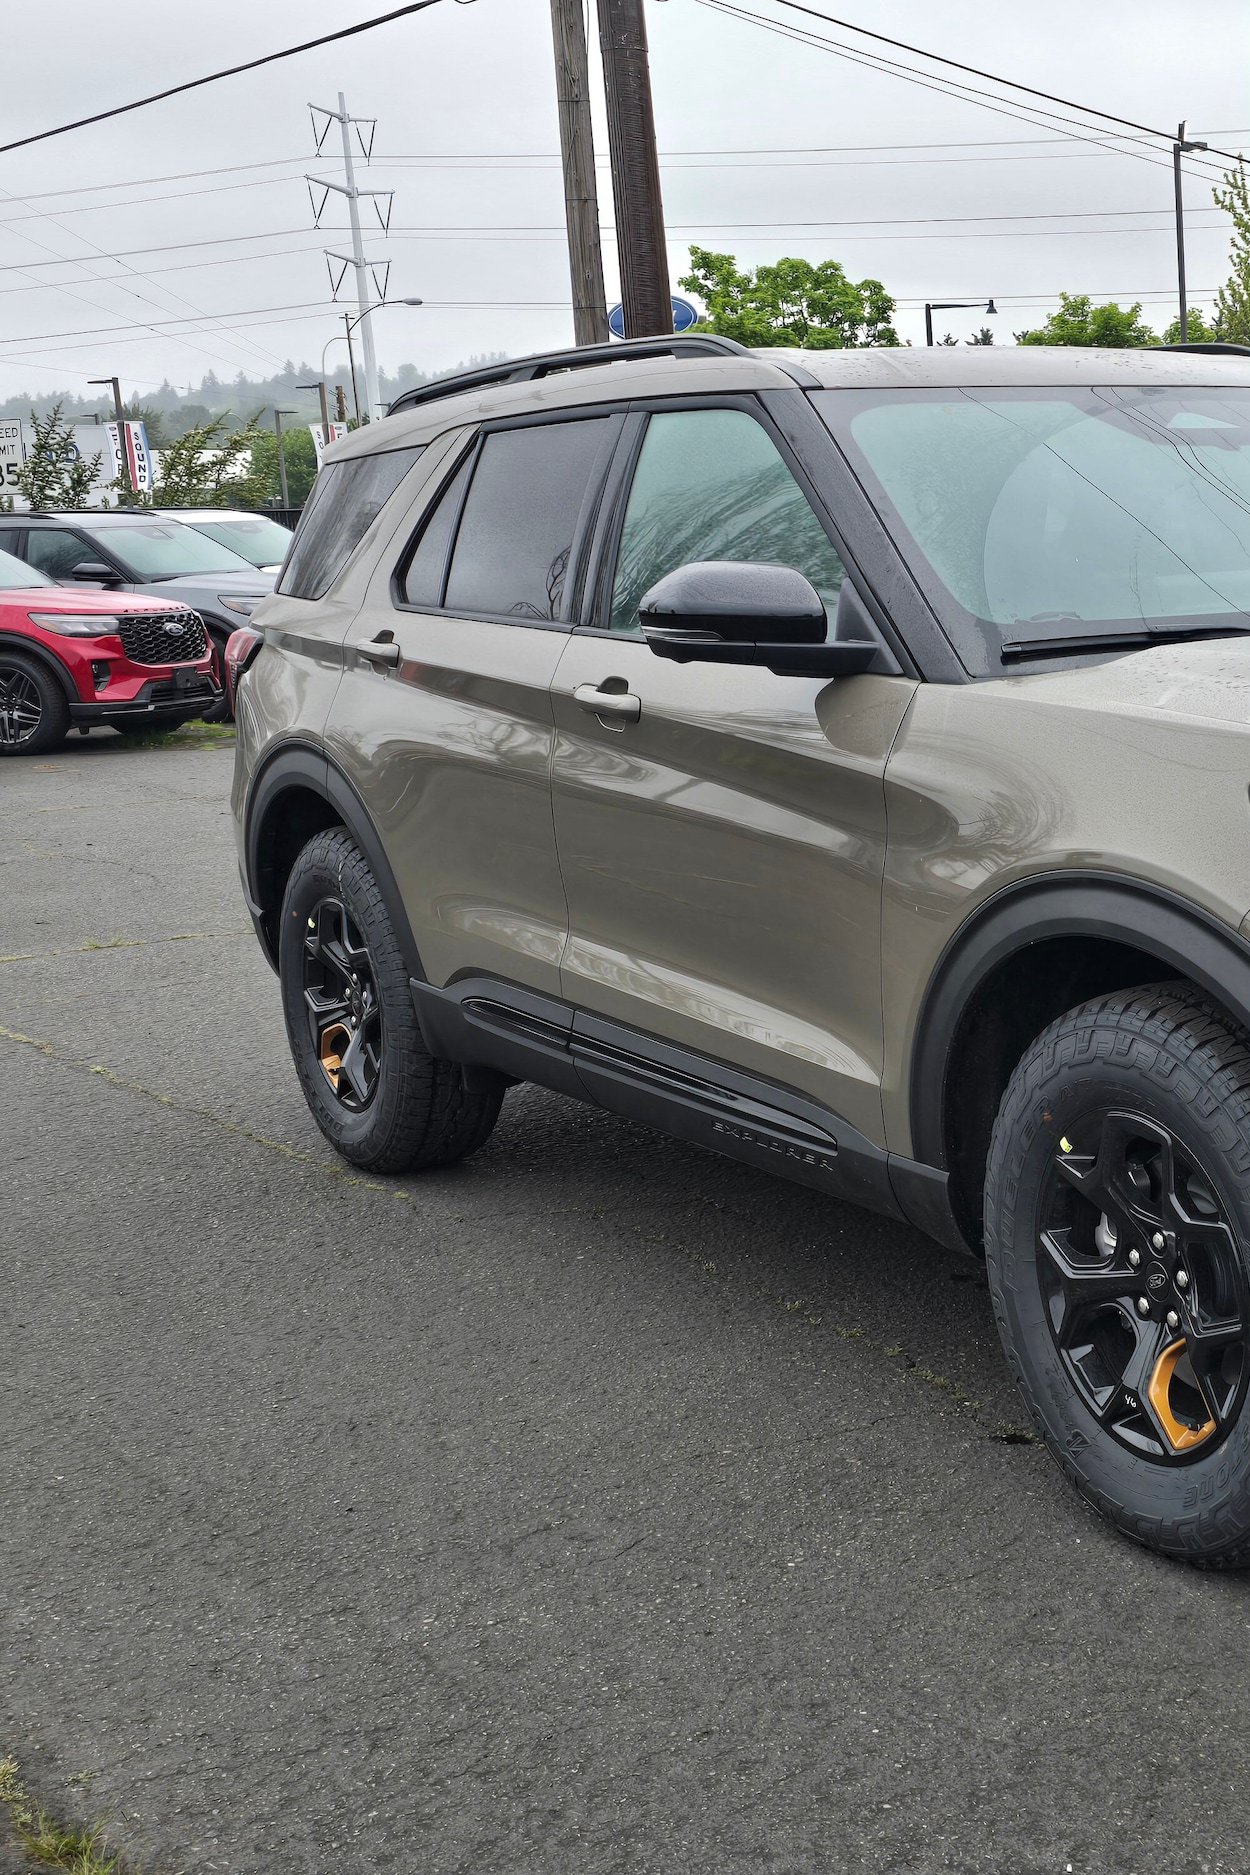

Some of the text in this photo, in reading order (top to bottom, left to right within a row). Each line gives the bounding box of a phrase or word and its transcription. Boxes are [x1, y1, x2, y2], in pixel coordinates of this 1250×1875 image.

[134, 432, 146, 483] SOUND
[711, 1121, 834, 1172] EXPLORER
[1124, 1393, 1138, 1409] 46
